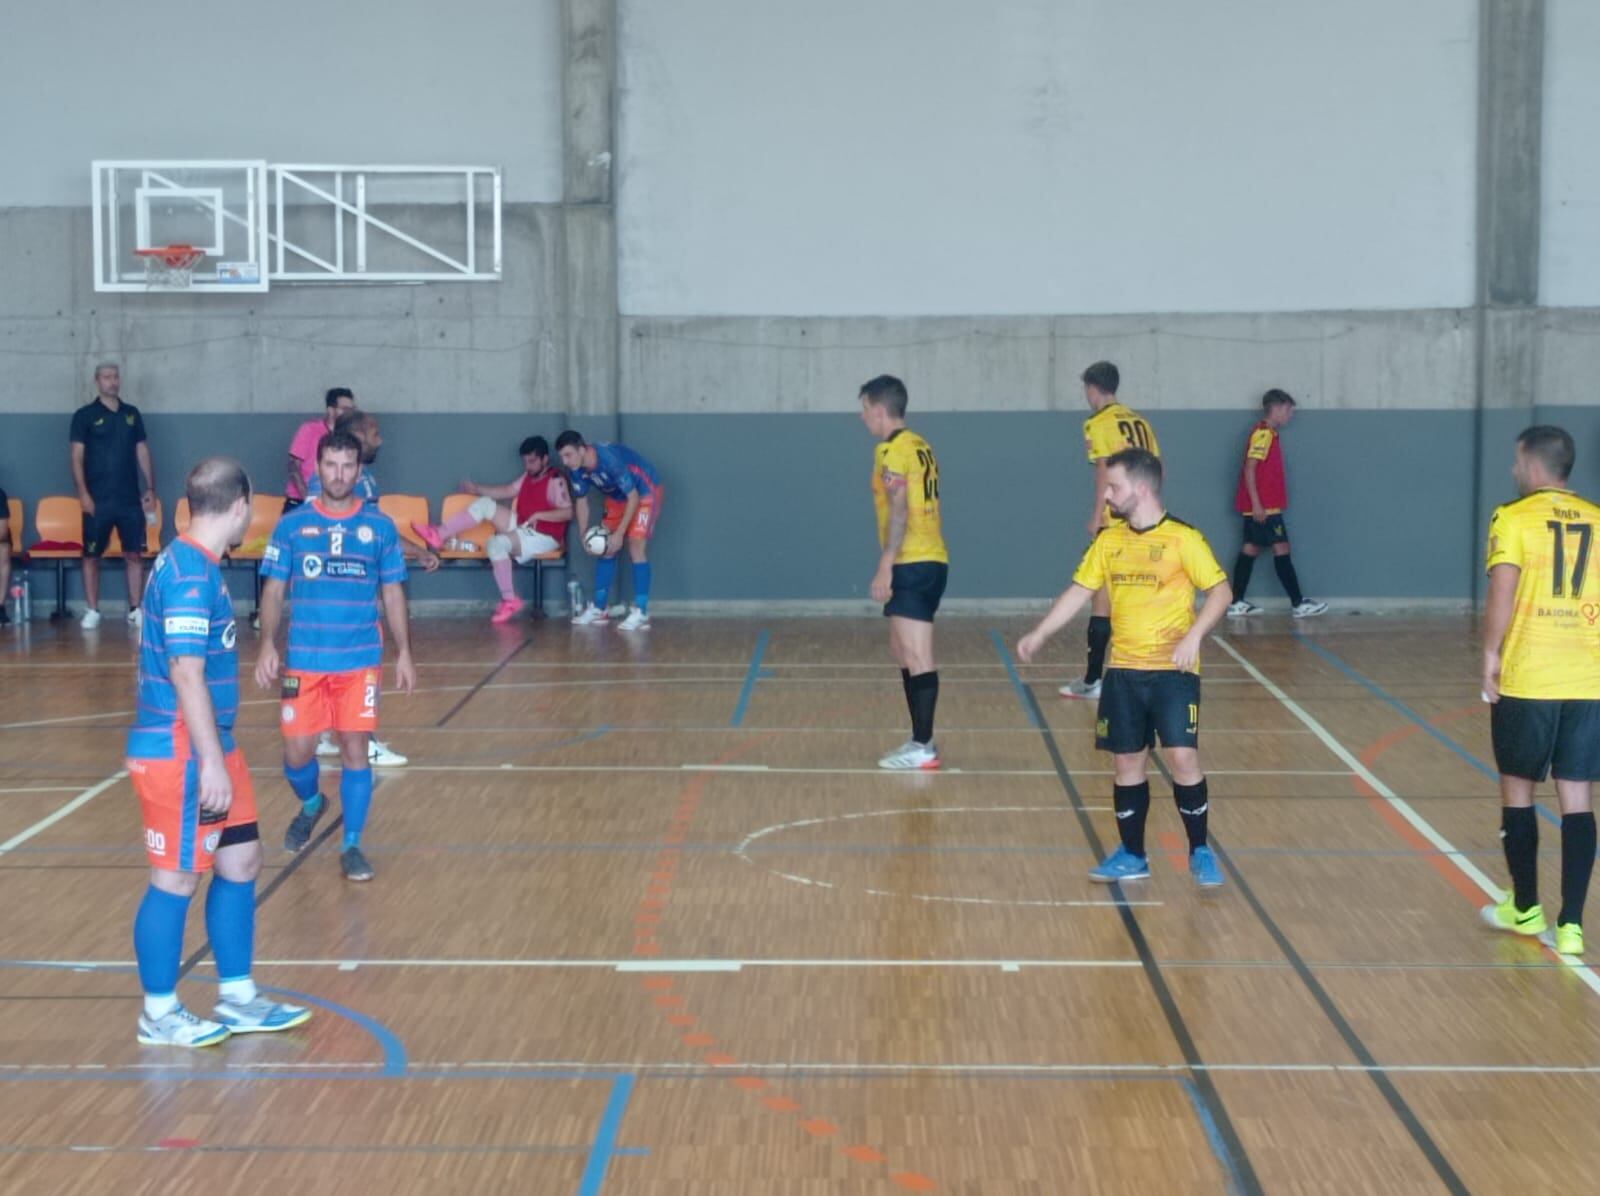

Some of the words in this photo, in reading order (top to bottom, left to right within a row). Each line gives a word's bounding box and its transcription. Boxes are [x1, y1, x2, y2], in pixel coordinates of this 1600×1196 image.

[331, 532, 342, 555] 2
[1546, 520, 1594, 599] 17
[364, 685, 375, 707] 2
[1187, 704, 1198, 724] 11
